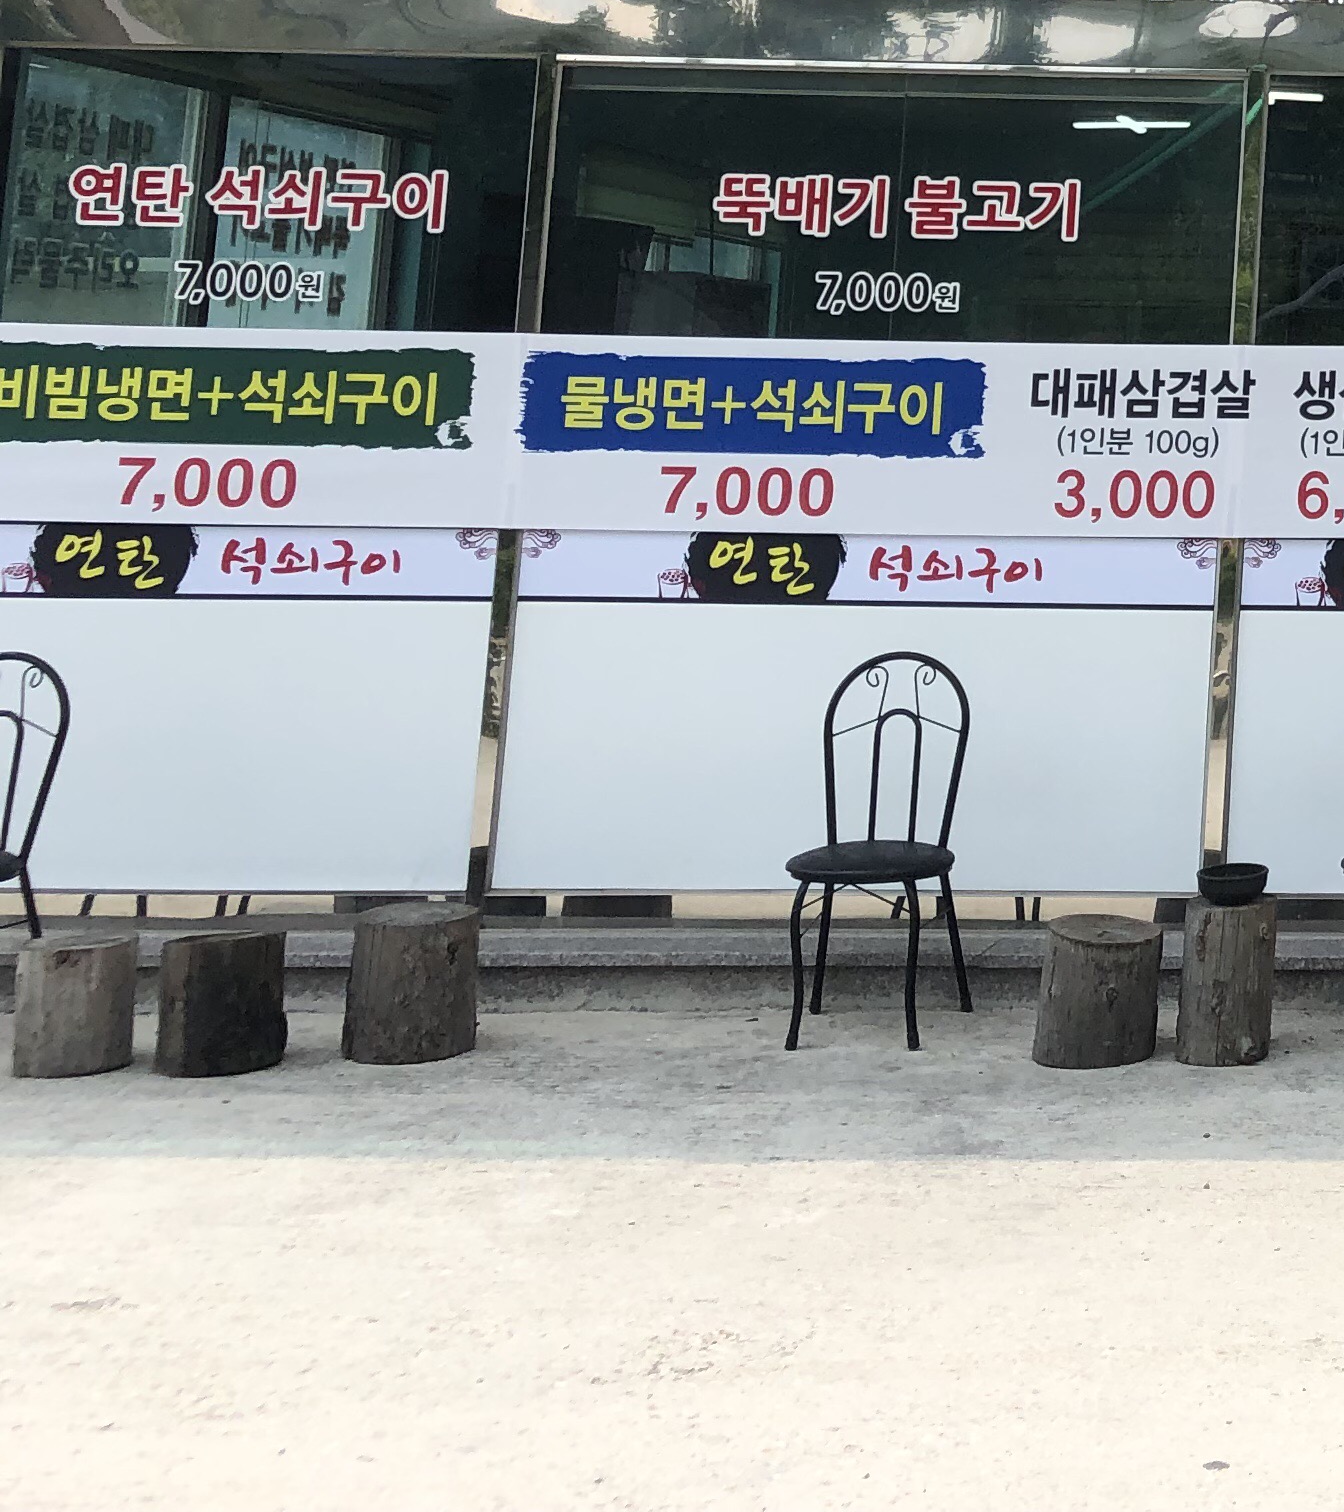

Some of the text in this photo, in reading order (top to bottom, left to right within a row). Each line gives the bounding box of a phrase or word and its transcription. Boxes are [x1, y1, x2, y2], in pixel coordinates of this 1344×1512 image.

[68, 162, 193, 228] 연탄
[207, 168, 449, 232] 석쇠구이
[714, 172, 1082, 242] 뚝배기 불고기
[0, 364, 438, 427] 비빔냉면+석쇠구이
[560, 375, 944, 436] 물냉면+석쇠구이
[1029, 366, 1258, 420] 대패삼겹살
[1056, 424, 1220, 460] (1인분 100g)
[118, 455, 298, 512] 7,000
[660, 464, 836, 520] 7,000
[1053, 468, 1217, 523] 3,000
[54, 531, 402, 590] 연탄 석쇠구이
[708, 537, 1044, 596] 연탄 석쇠구이
